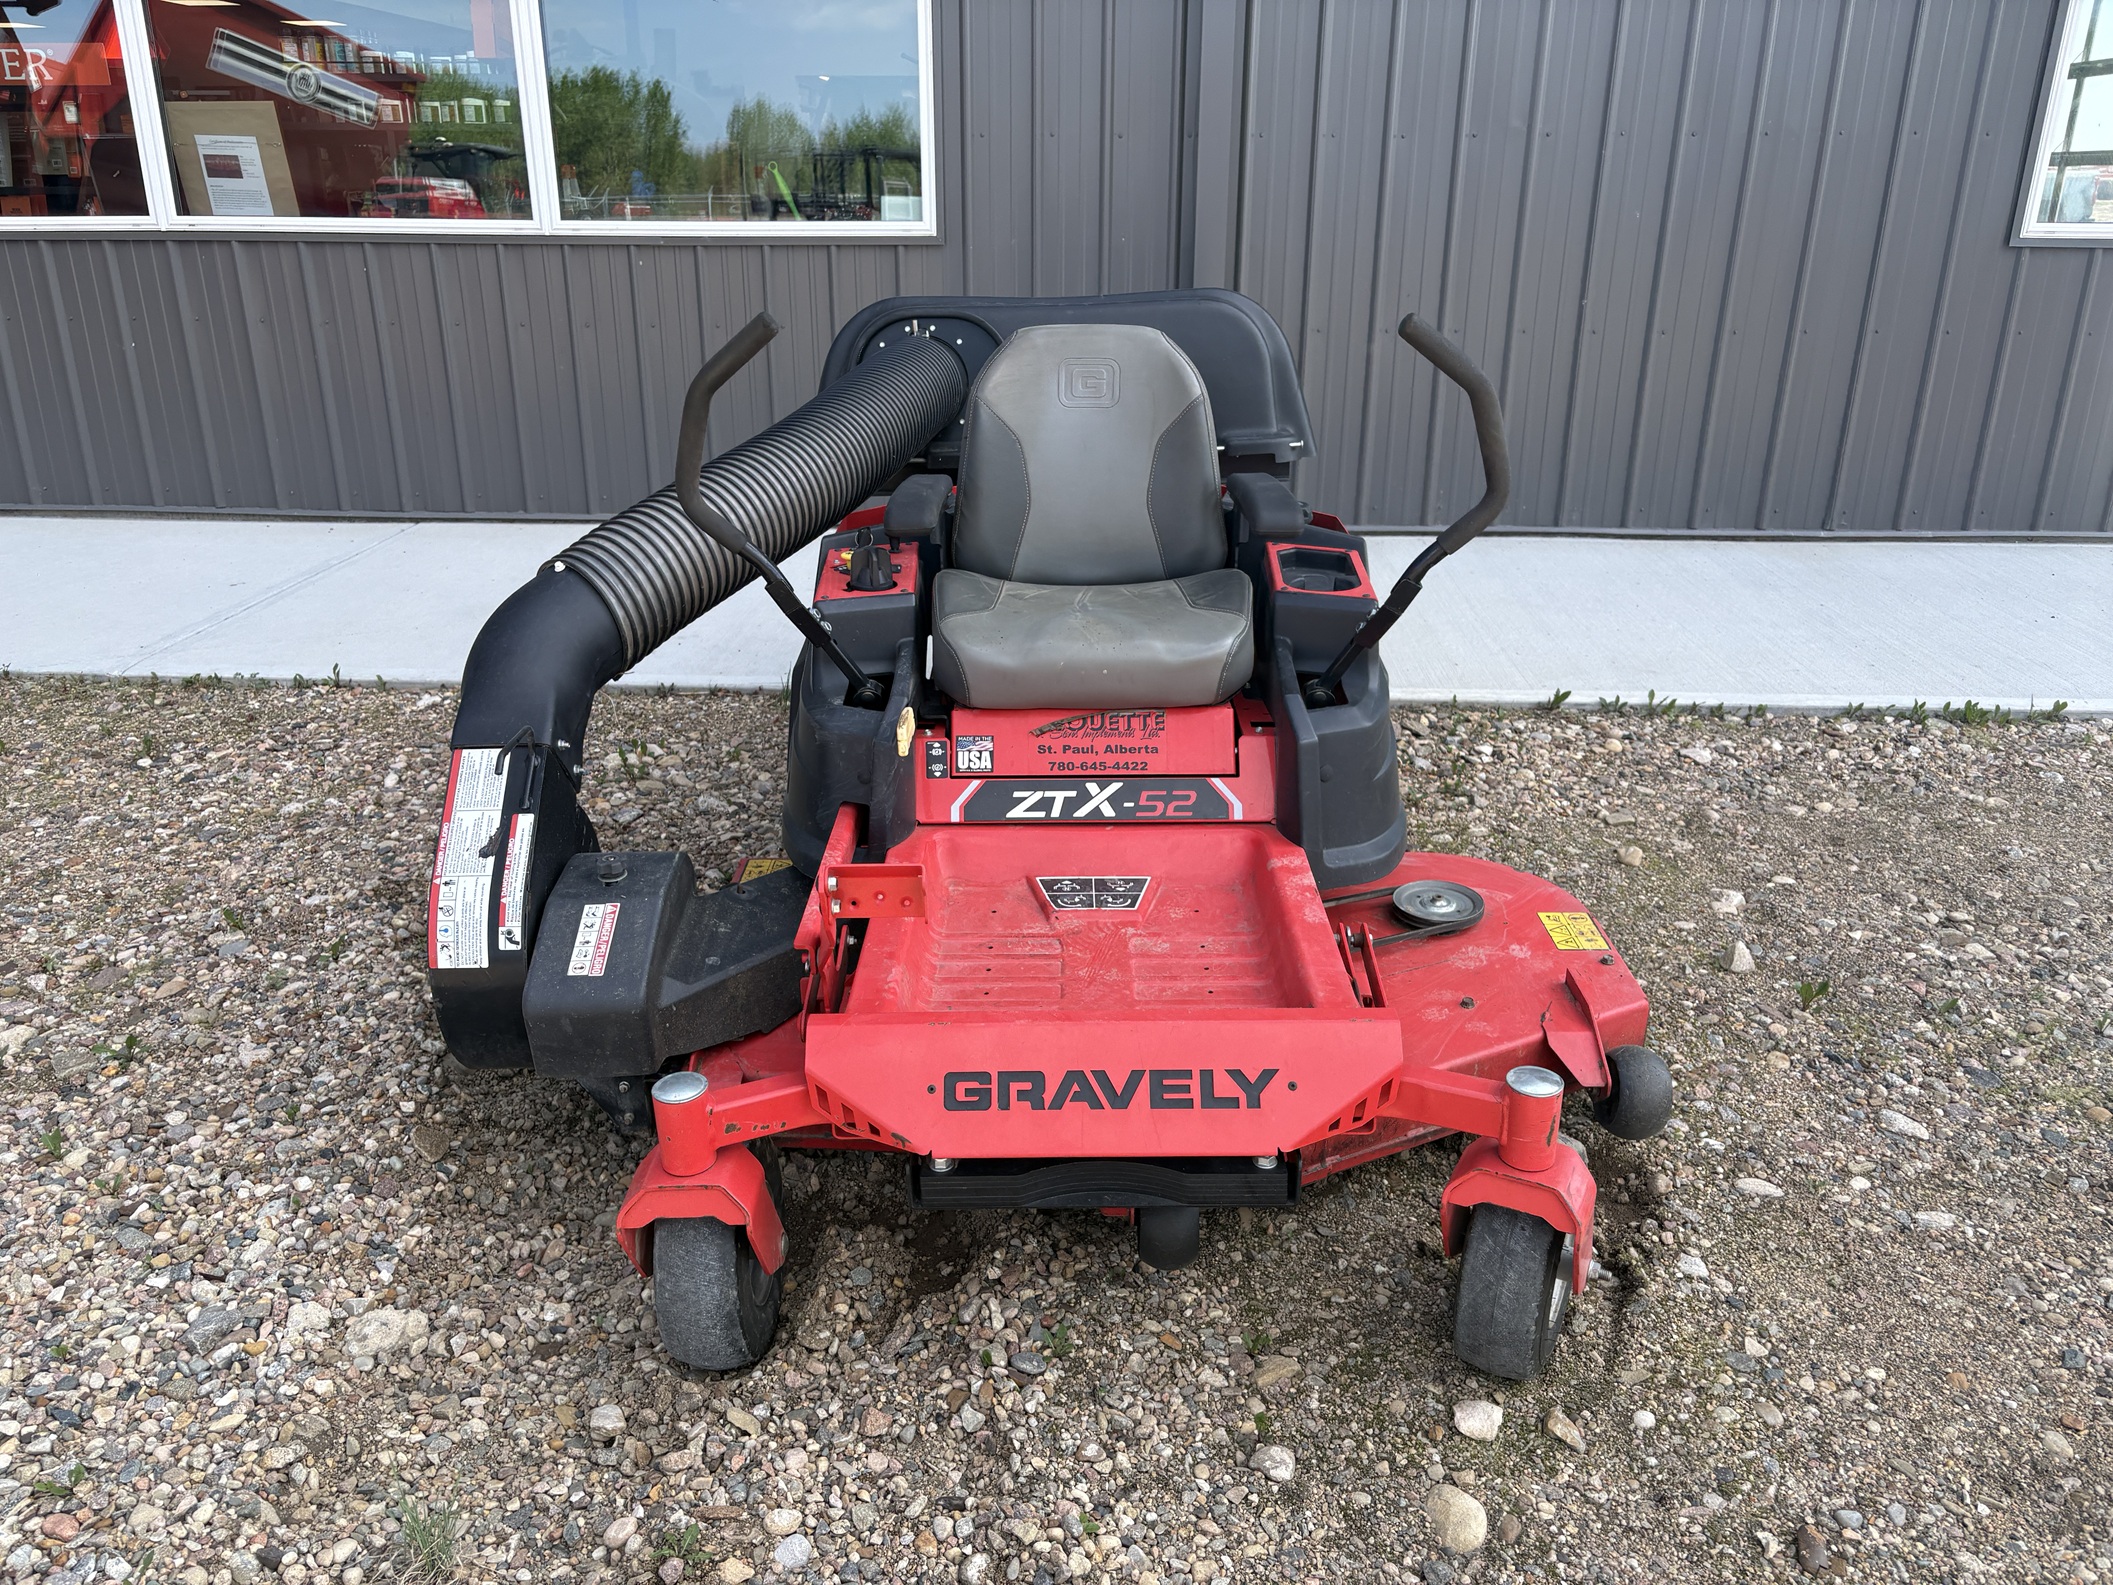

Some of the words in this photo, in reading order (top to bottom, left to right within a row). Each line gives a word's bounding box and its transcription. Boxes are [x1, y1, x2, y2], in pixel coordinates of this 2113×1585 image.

[1037, 744, 1057, 755] St.
[1062, 744, 1099, 756] Paul,
[1104, 744, 1159, 755] Alberta
[957, 751, 992, 769] USA
[1048, 761, 1149, 772] 780-645-4422
[502, 870, 510, 895] DANGER
[506, 838, 514, 864] PELIGRO
[943, 1068, 1280, 1112] GRAVELY
